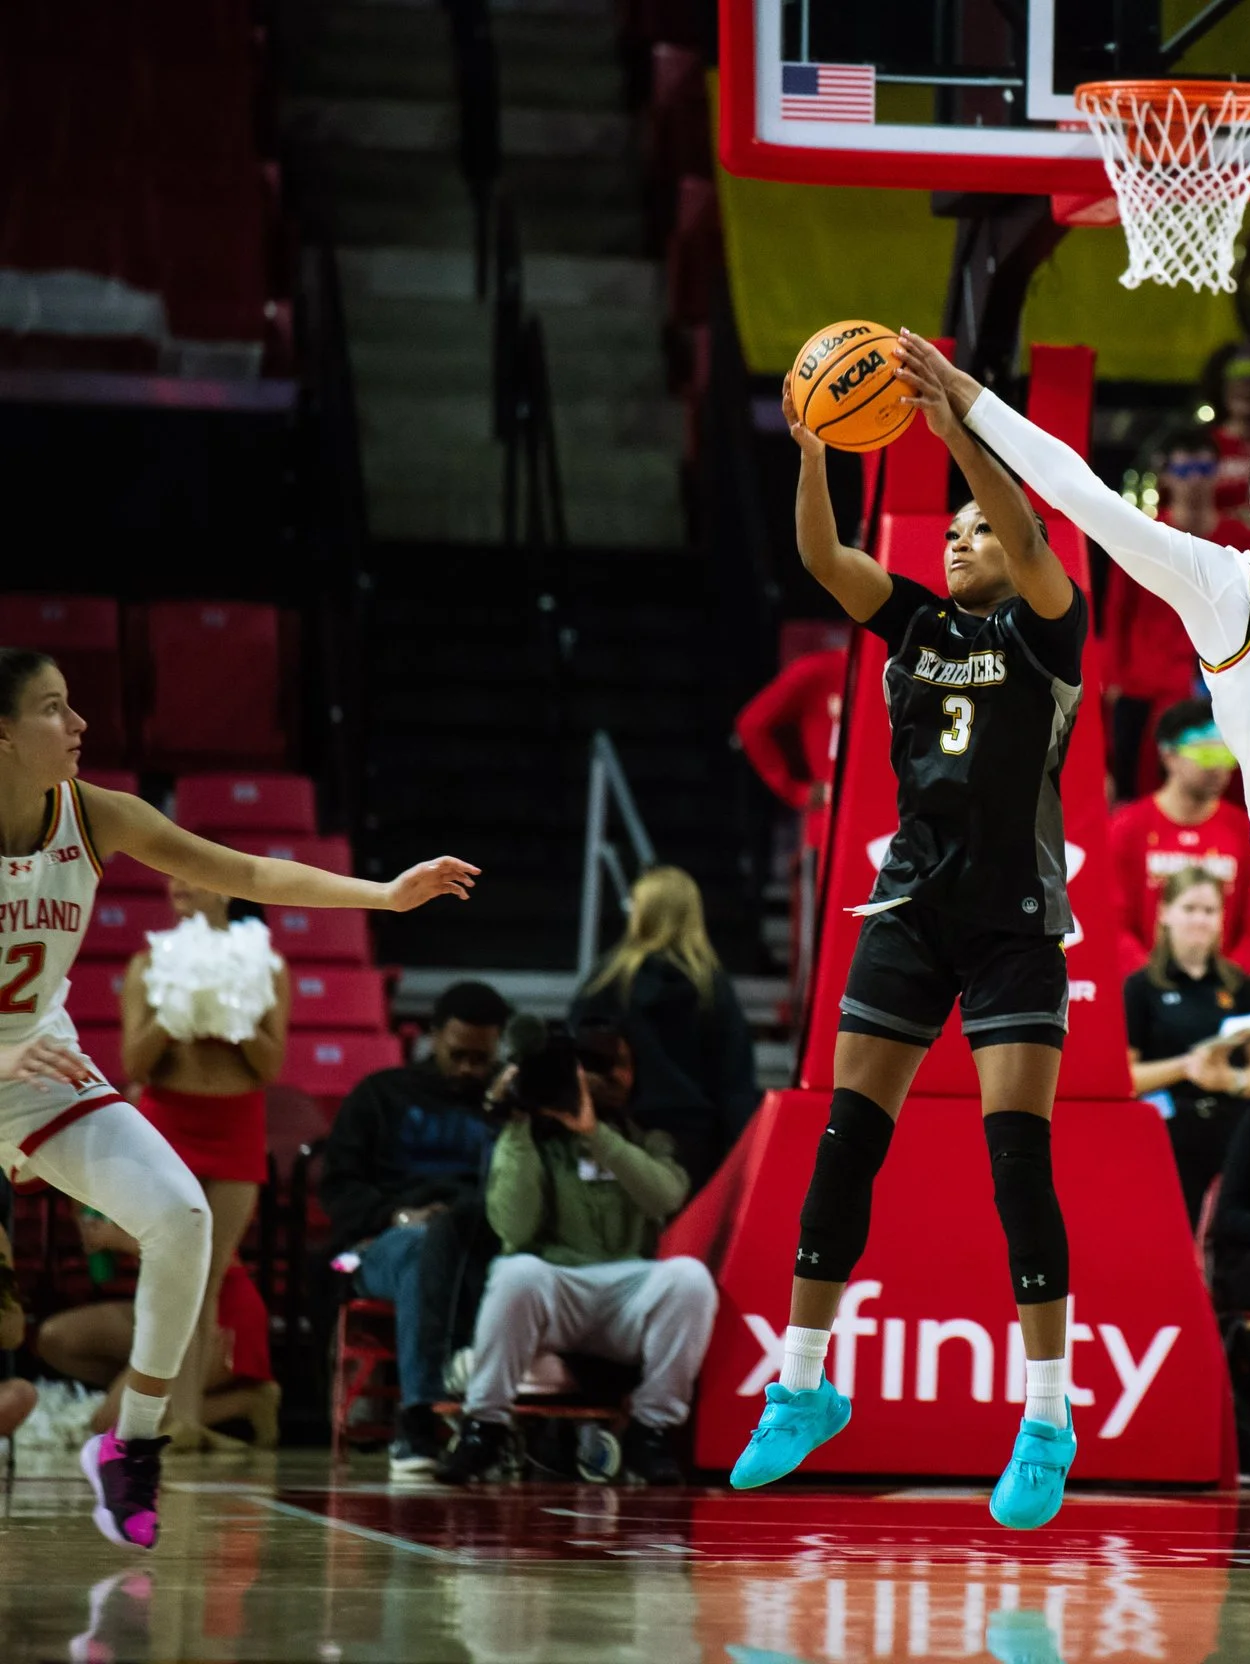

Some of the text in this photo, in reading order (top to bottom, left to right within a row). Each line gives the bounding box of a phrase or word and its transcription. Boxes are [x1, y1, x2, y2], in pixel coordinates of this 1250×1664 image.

[799, 326, 871, 380] Wilson
[828, 349, 886, 402] NCAA
[914, 647, 1006, 688] RETRIEVERS
[940, 694, 974, 755] 3
[0, 941, 46, 1014] 2
[736, 1280, 1181, 1438] xfinity
